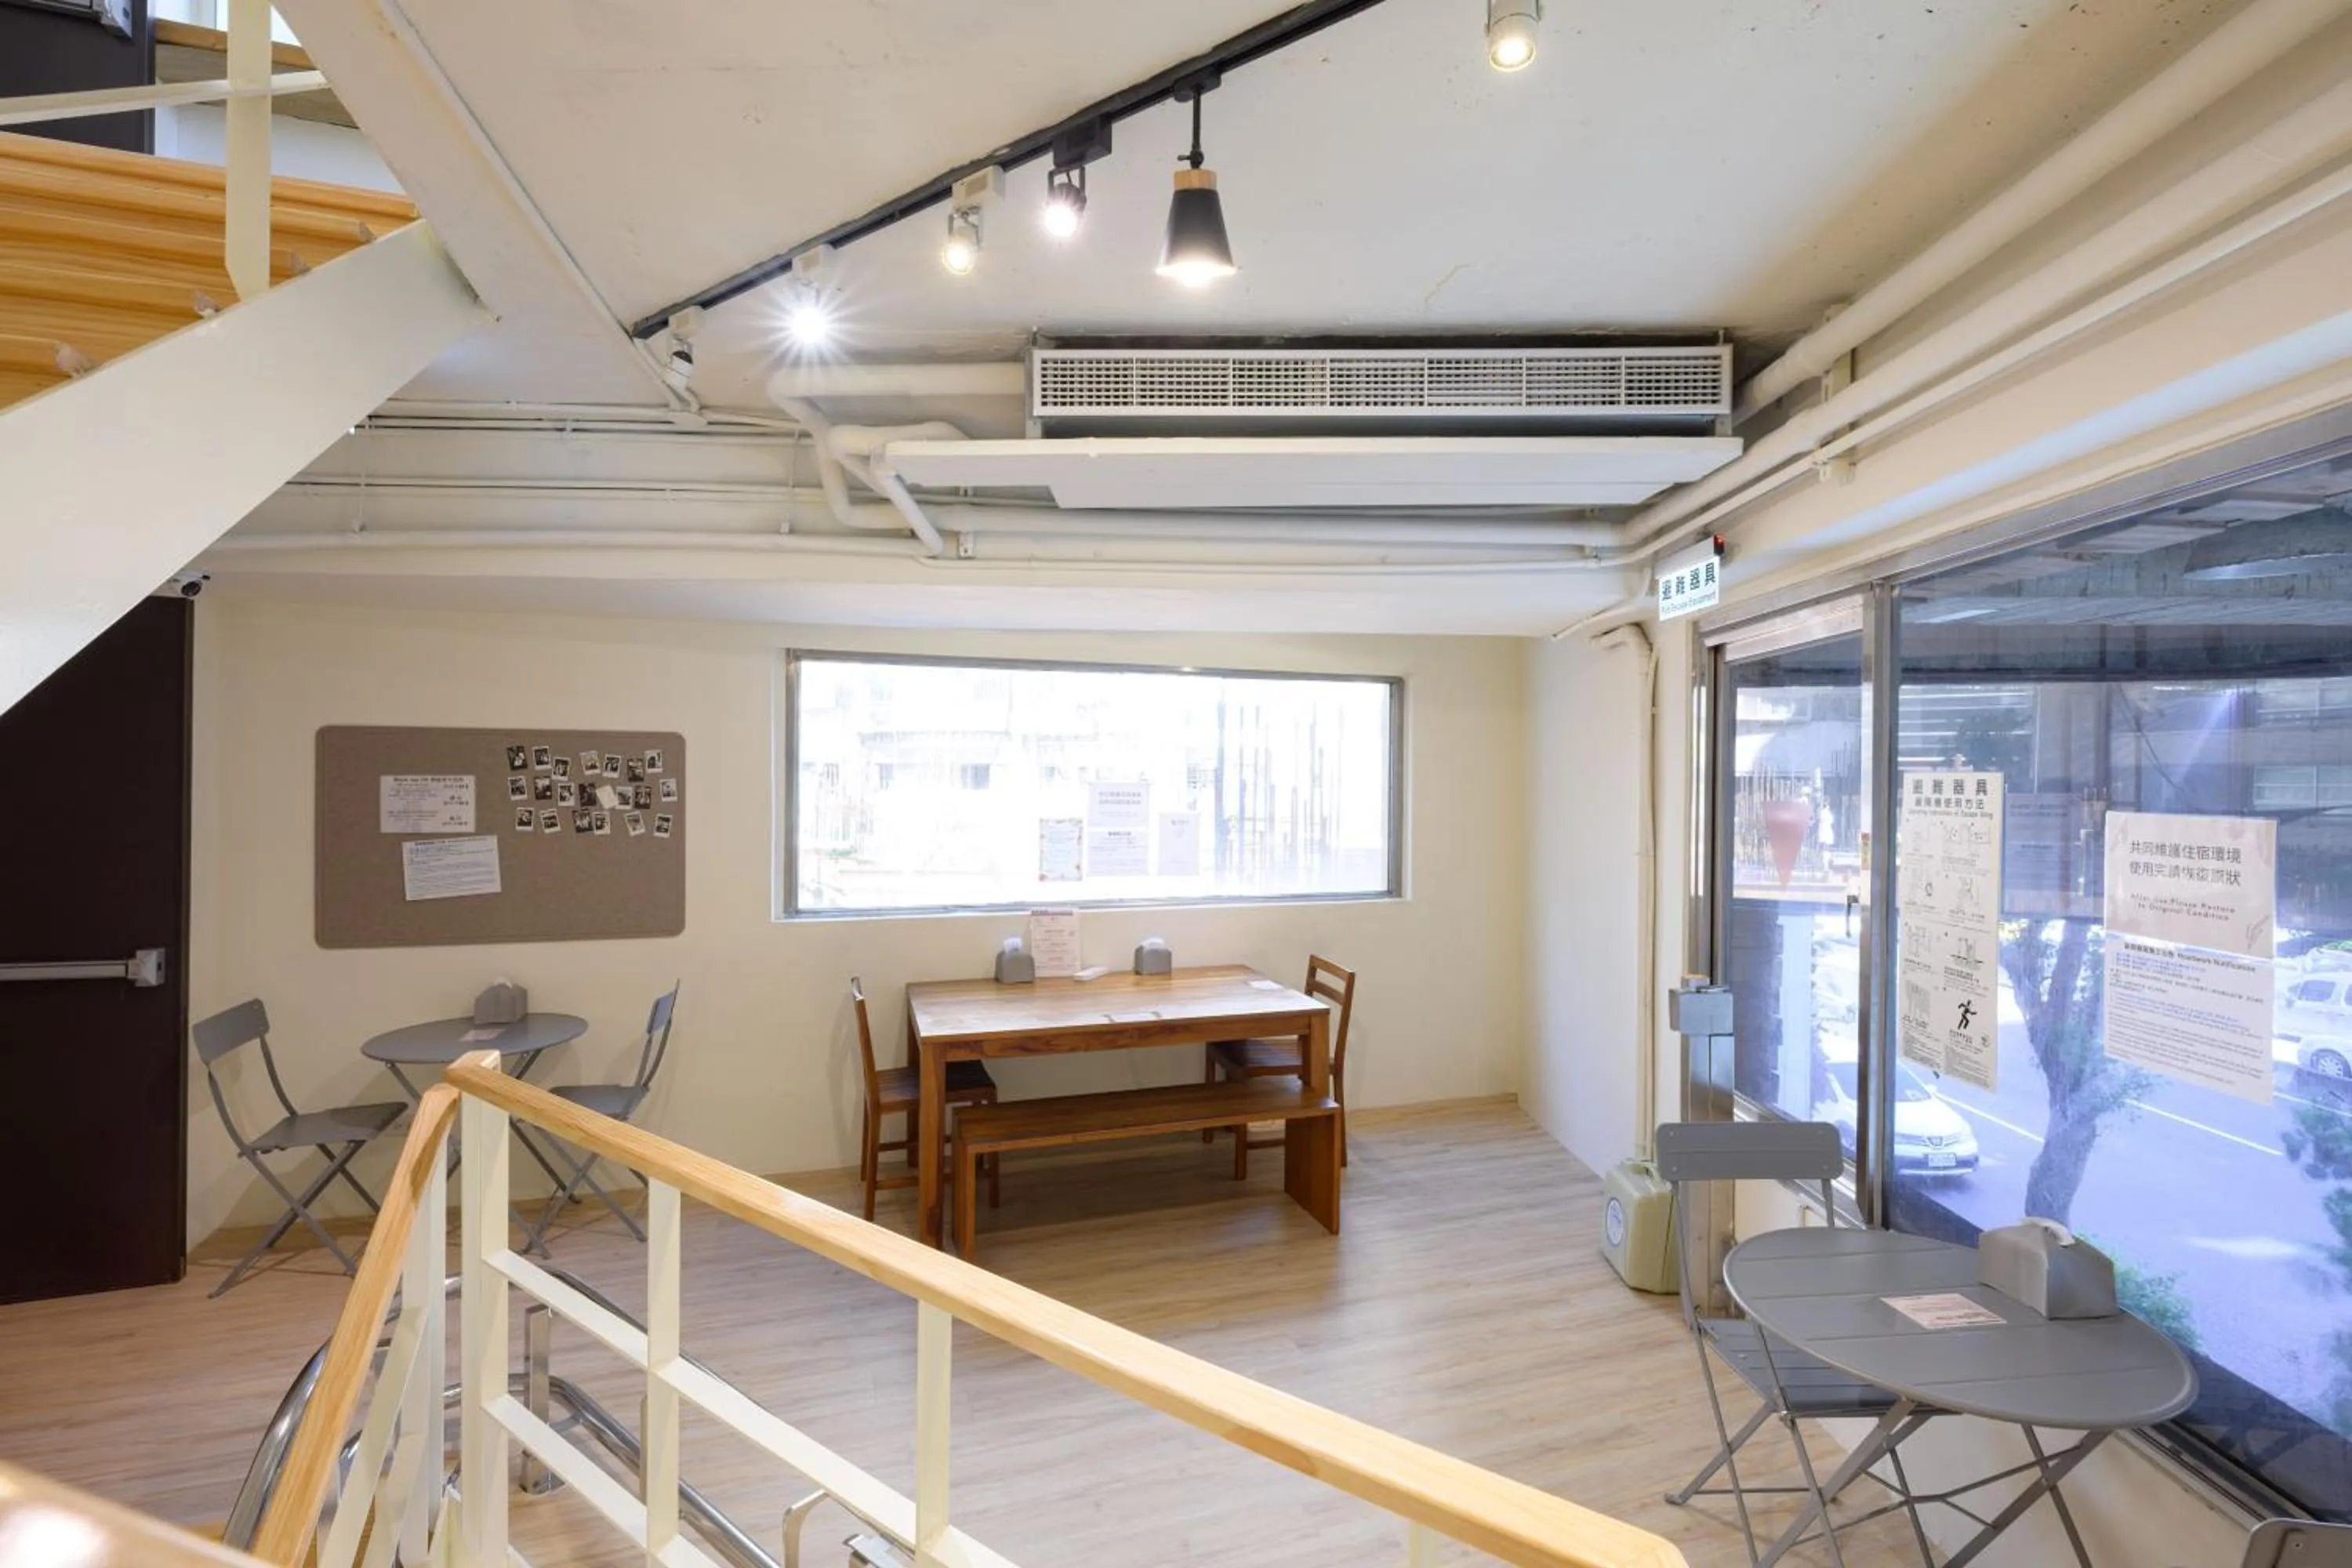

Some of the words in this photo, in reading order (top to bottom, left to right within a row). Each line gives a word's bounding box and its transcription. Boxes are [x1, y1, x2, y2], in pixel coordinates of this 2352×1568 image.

[1662, 562, 1715, 601] 避難器具
[1912, 779, 1987, 796] 避難器具
[2129, 840, 2241, 864] 共同維護住宿環境
